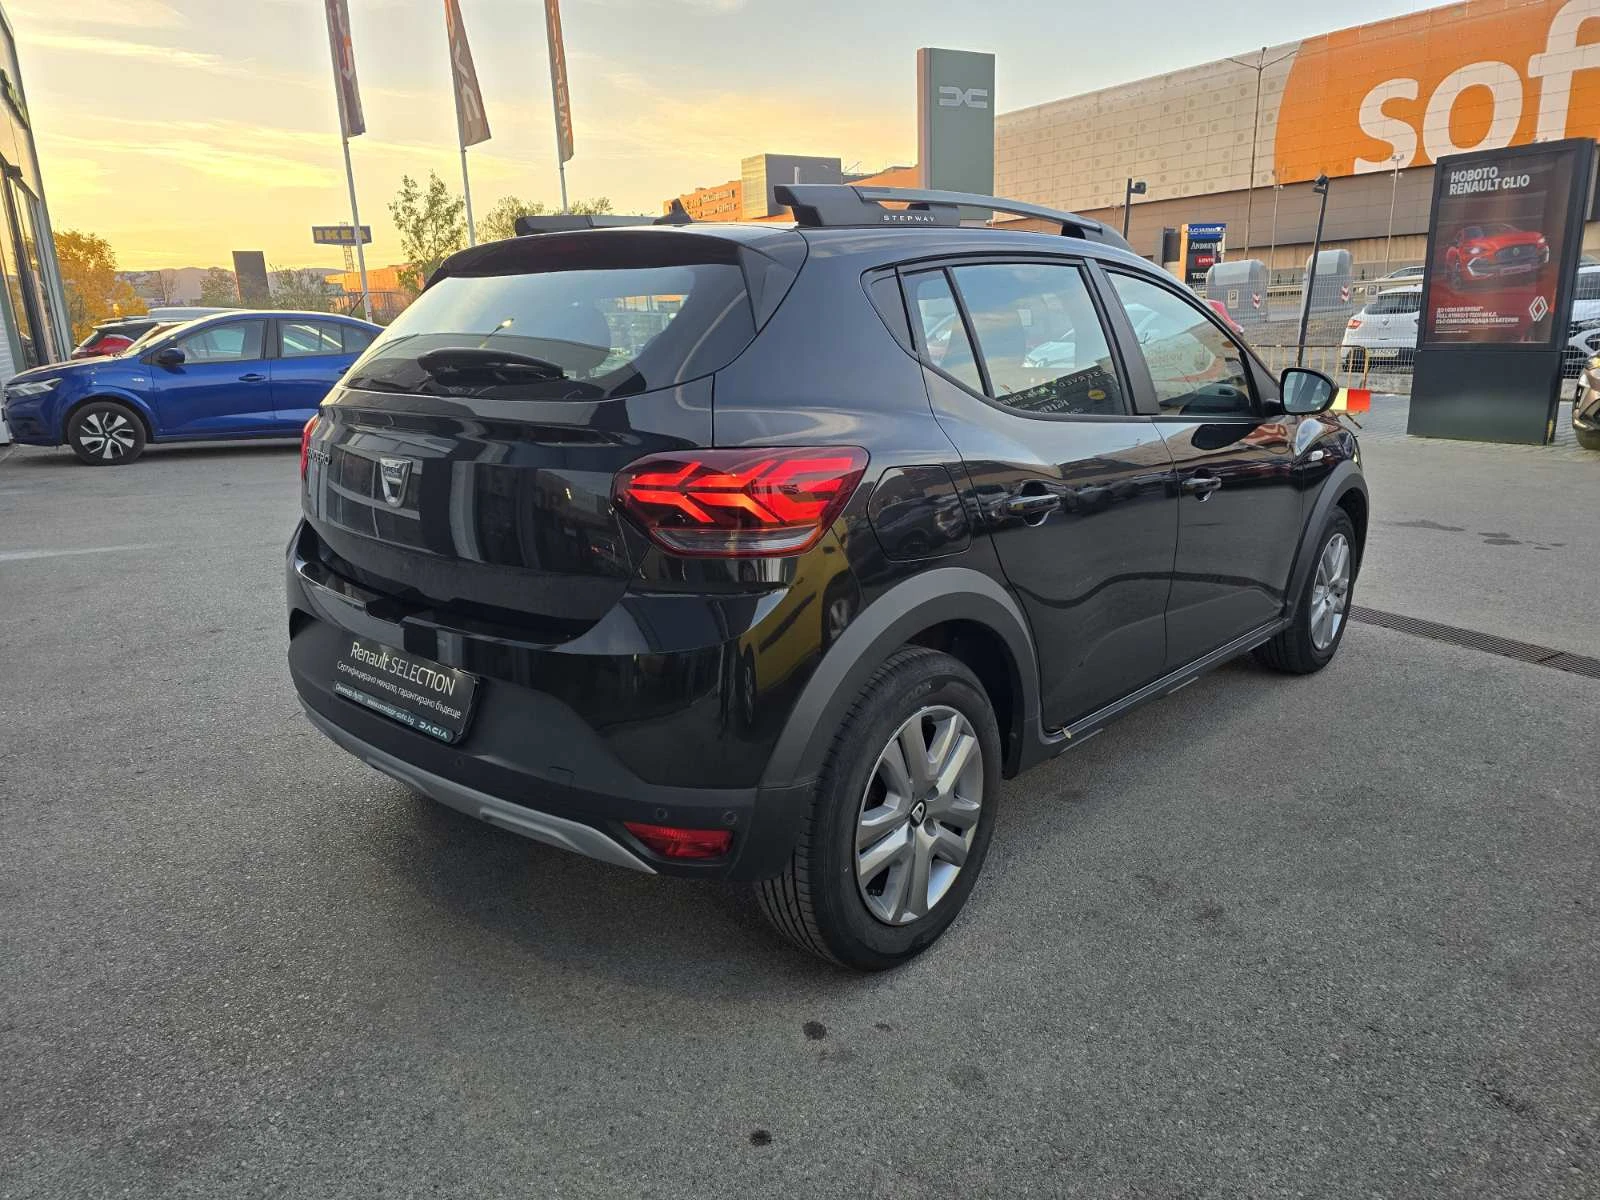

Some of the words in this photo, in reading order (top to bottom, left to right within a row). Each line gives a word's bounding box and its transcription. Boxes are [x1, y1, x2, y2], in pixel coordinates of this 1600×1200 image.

[1449, 178, 1501, 195] RENAULT
[1502, 174, 1530, 189] CLIO
[315, 229, 368, 240] IKEA
[350, 641, 390, 671] Renault
[389, 656, 456, 697] SELECTION
[418, 721, 448, 739] DACIA
